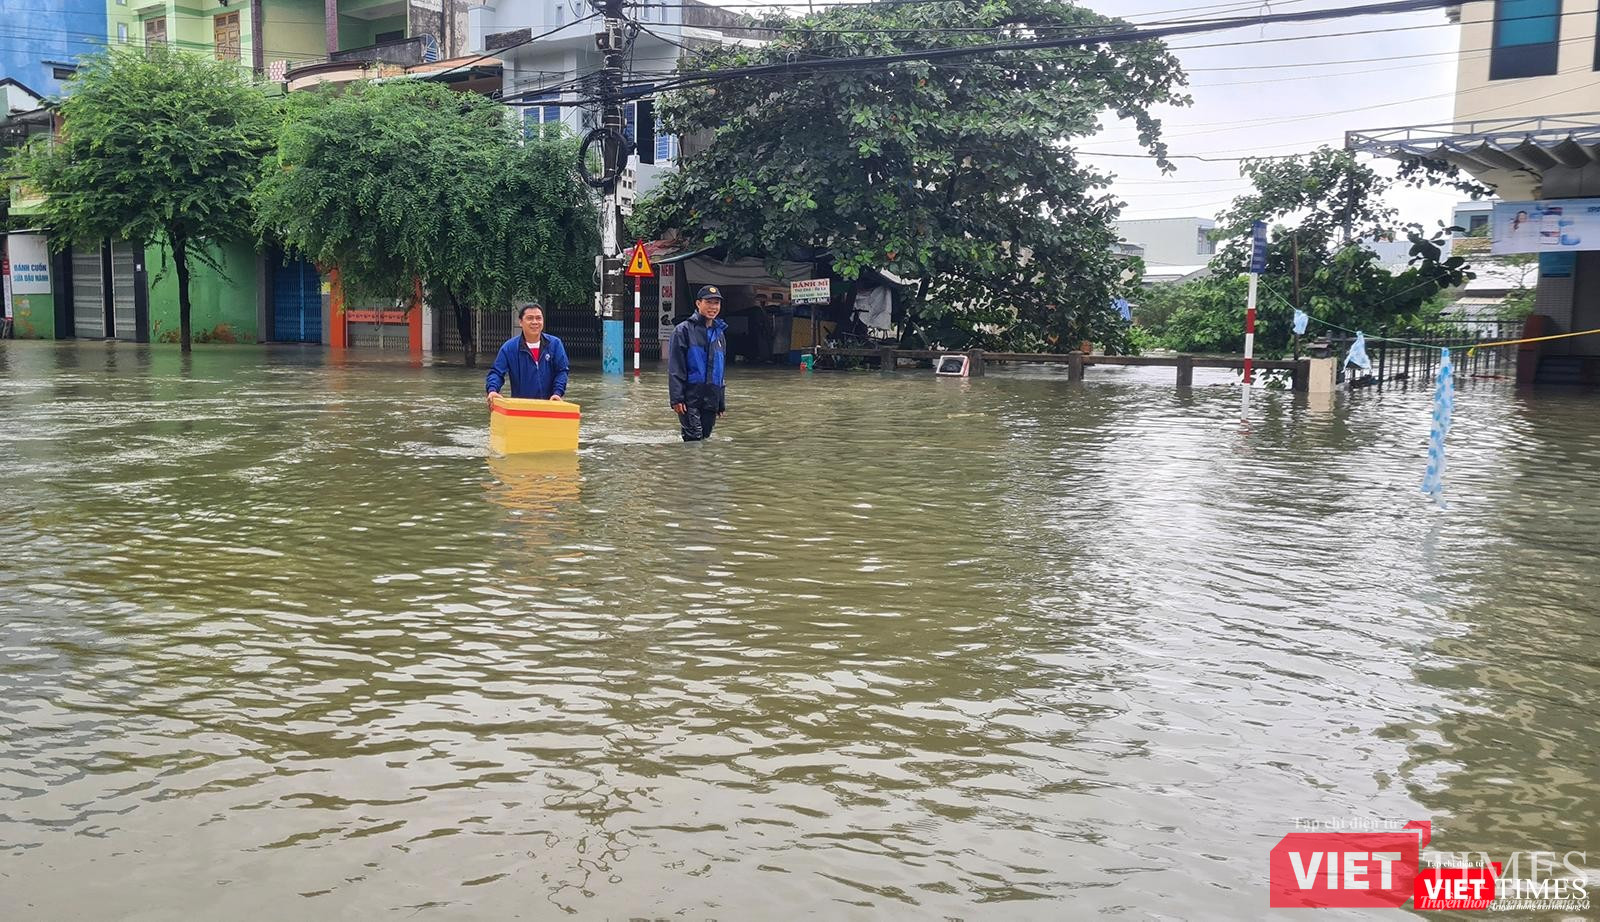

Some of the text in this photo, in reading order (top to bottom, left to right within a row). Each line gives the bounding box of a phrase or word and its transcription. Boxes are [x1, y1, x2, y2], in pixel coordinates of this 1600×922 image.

[13, 263, 30, 272] BÁNH
[31, 262, 47, 272] CUỐN
[660, 264, 674, 276] NEM
